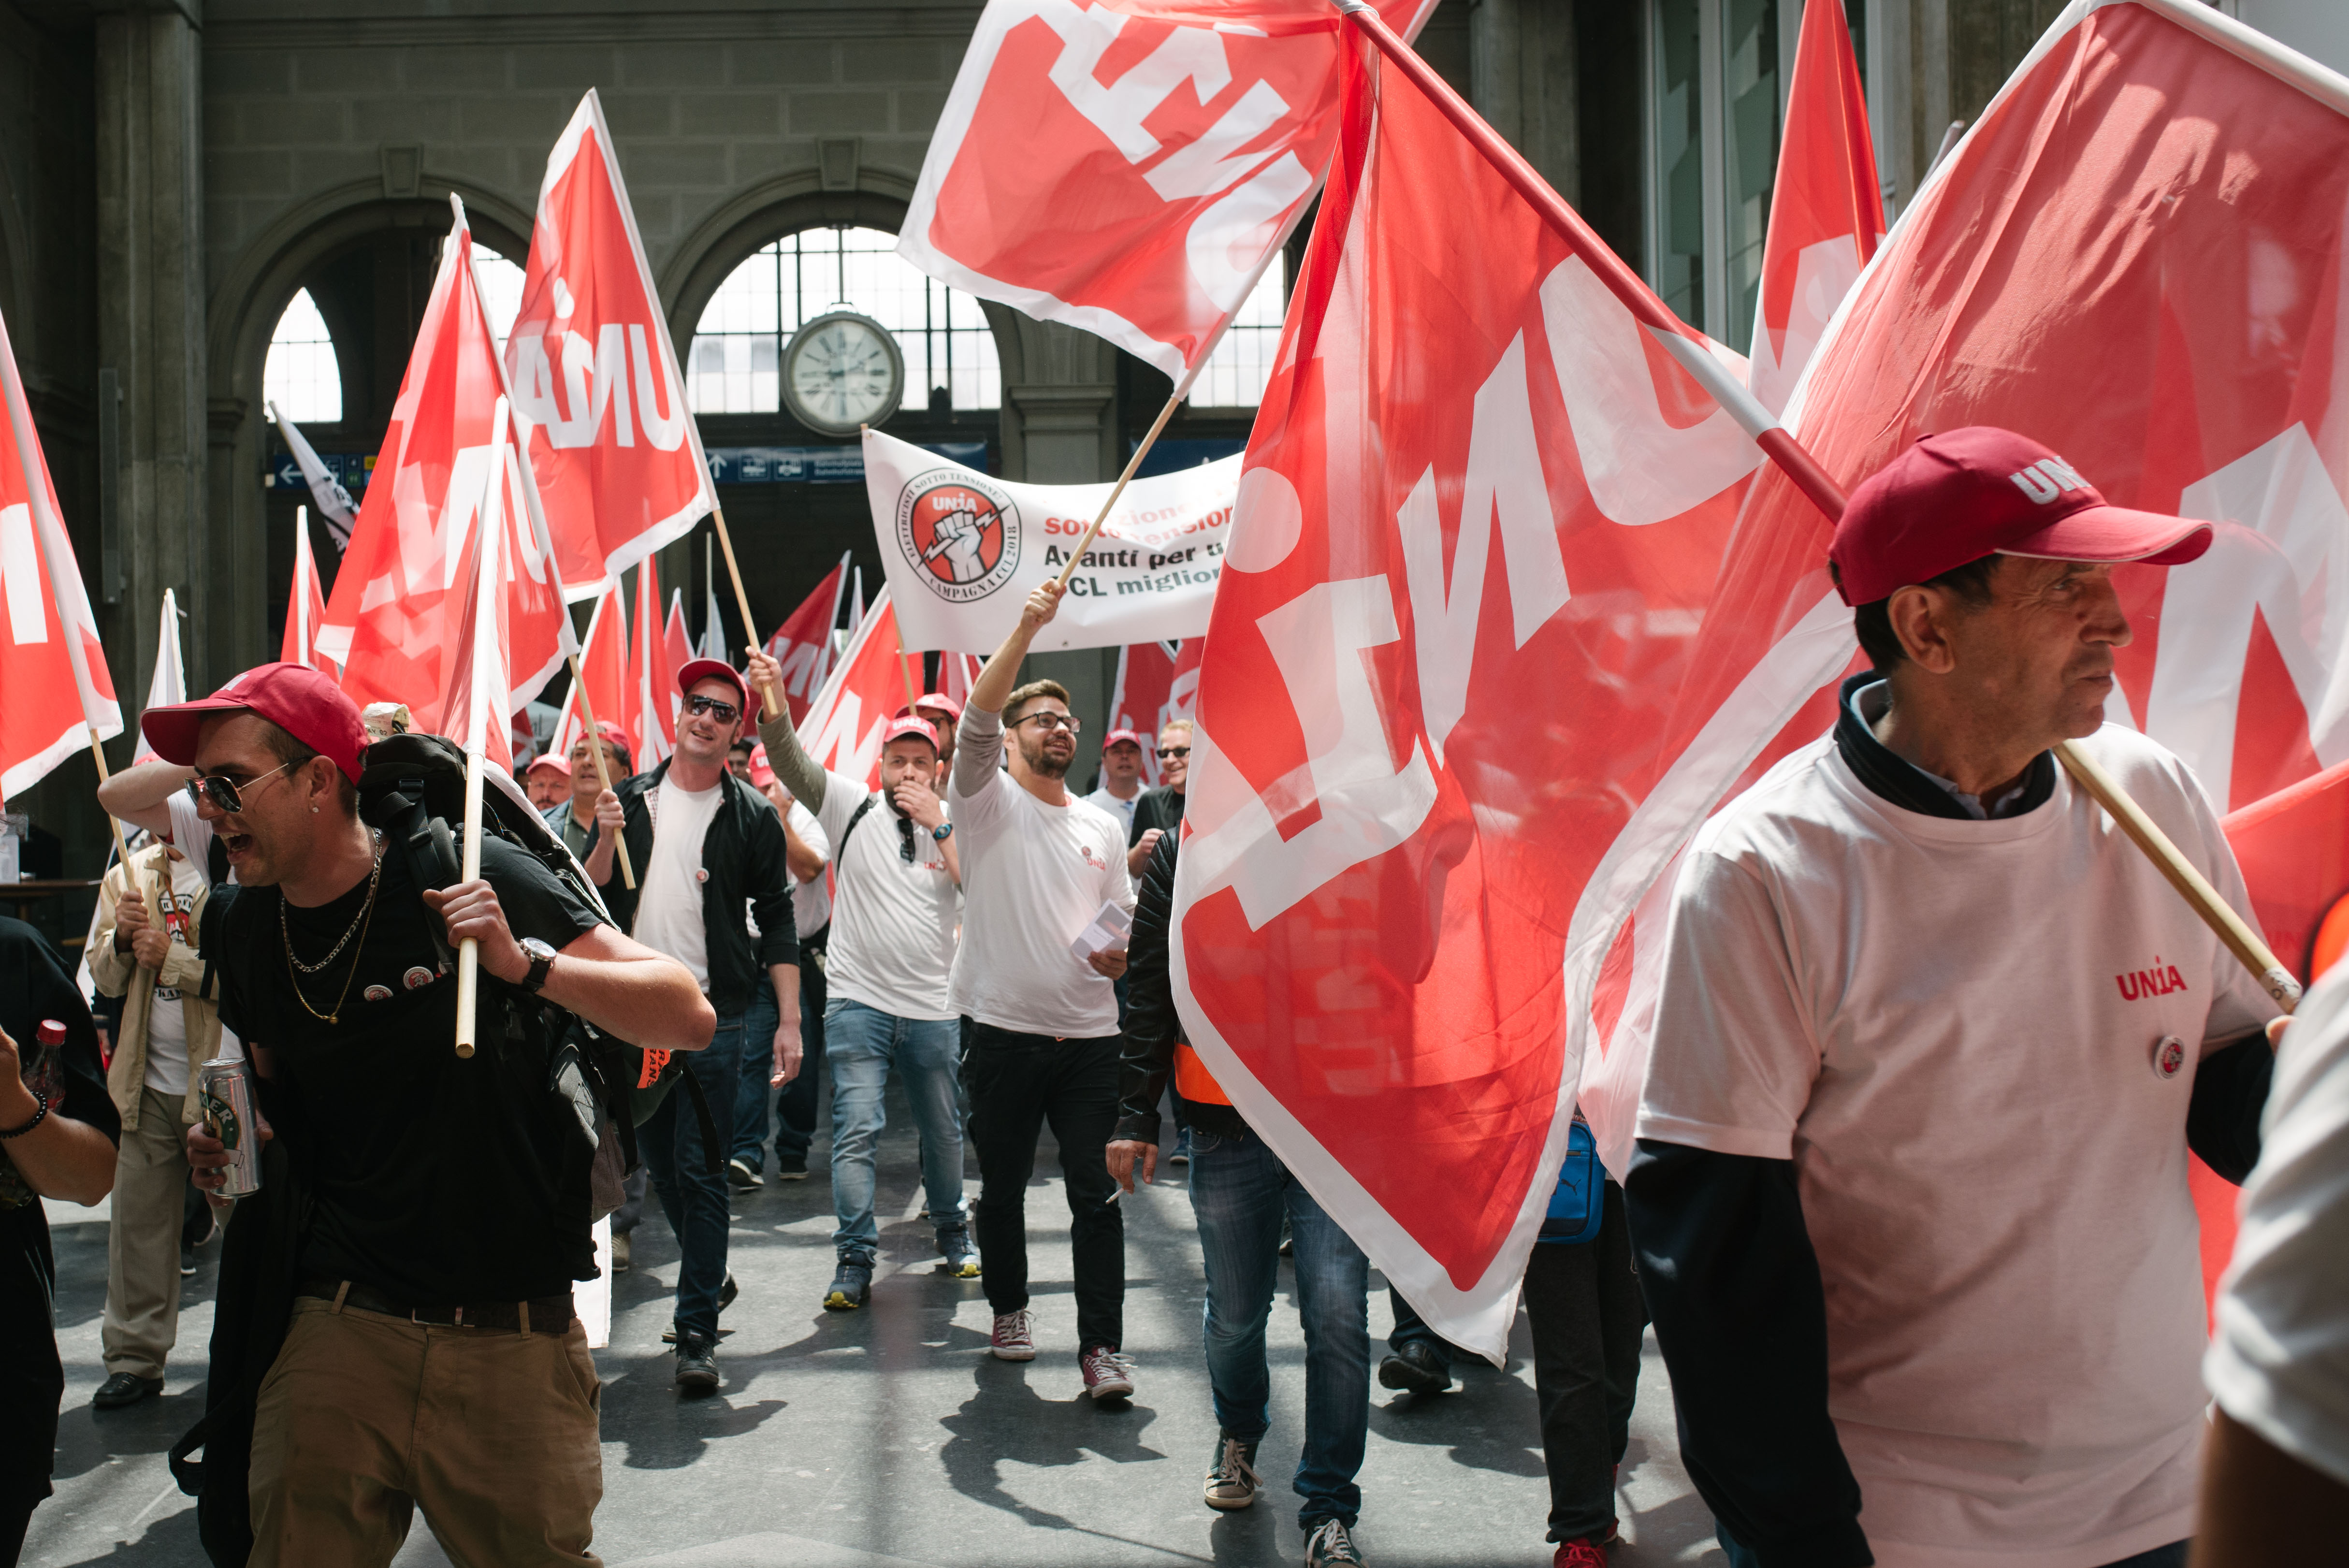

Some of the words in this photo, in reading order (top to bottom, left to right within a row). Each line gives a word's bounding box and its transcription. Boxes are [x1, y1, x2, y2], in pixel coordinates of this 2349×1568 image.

[915, 473, 946, 491] SOTTO
[929, 577, 995, 599] CAMPAGNA
[996, 558, 1014, 580] CCL
[1007, 526, 1017, 556] 2018
[1149, 547, 1196, 570] per
